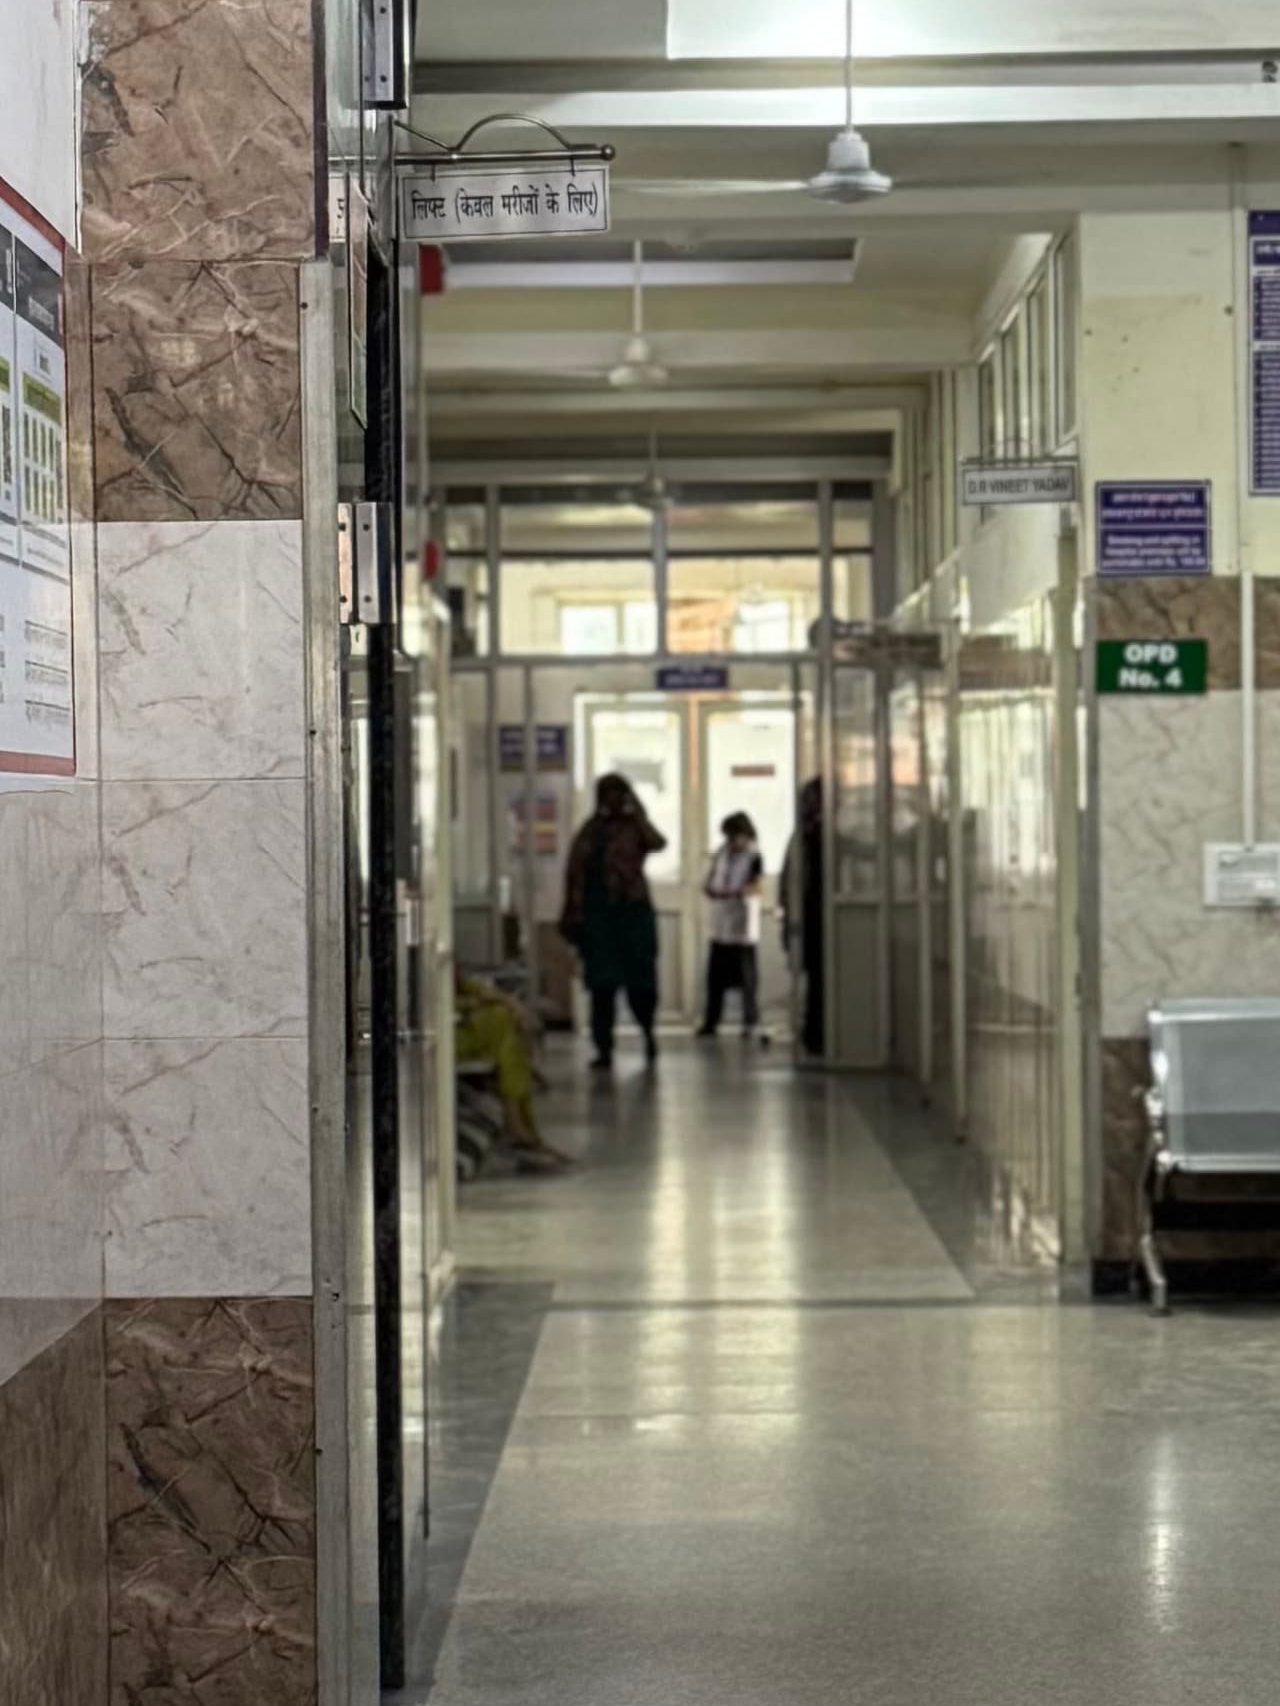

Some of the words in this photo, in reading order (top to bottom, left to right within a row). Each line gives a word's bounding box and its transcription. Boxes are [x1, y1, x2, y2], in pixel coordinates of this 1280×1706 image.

[411, 189, 446, 222] लिफ्ट
[455, 187, 494, 225] (केवल
[501, 184, 539, 216] मरीजों
[546, 183, 560, 215] के
[566, 180, 599, 218] लिए)
[1124, 643, 1178, 665] OPD
[1118, 667, 1159, 689] No.
[1164, 667, 1183, 689] 4
